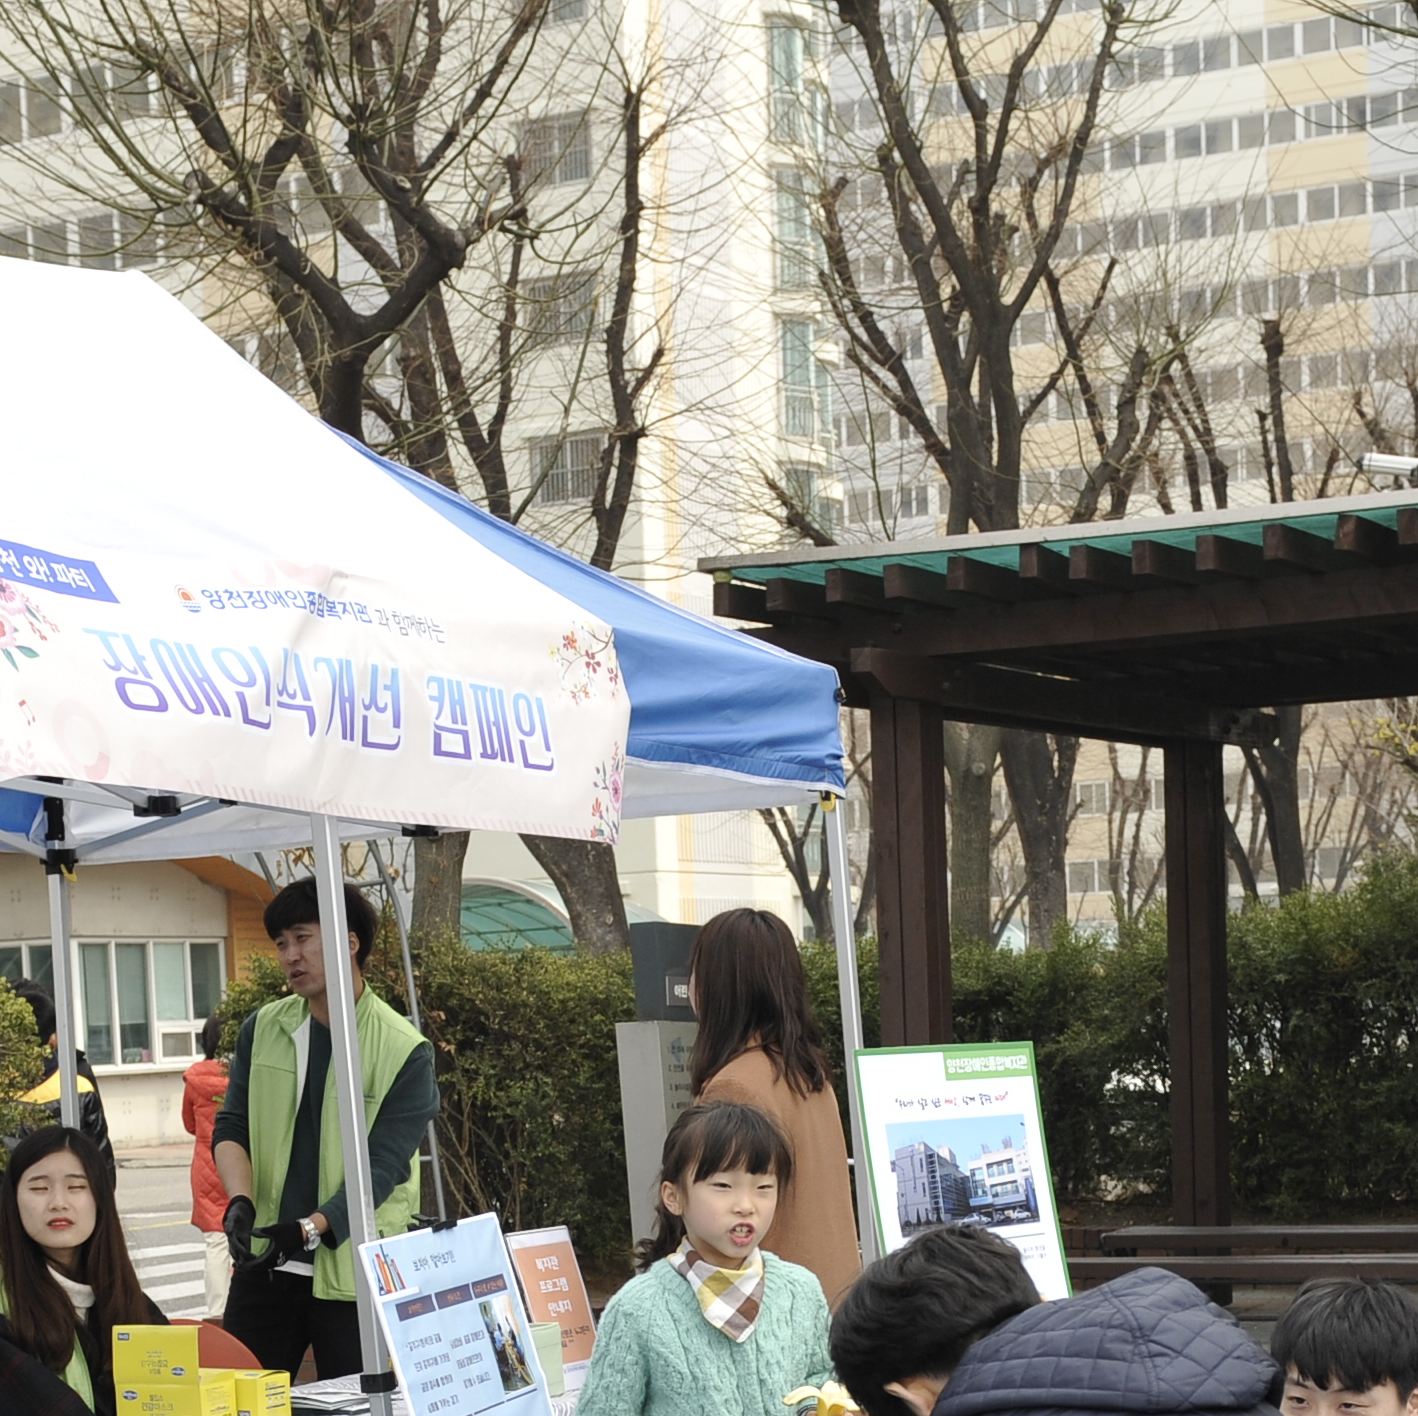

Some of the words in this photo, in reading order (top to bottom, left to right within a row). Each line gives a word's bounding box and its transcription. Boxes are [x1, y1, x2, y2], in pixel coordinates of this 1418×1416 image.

[23, 555, 54, 583] 와!
[50, 562, 96, 593] 파티
[201, 589, 373, 623] 양천장애인종합복지관
[83, 627, 401, 751] 장애인식개선
[426, 672, 557, 772] 캠페인
[538, 1276, 570, 1293] 프로그램
